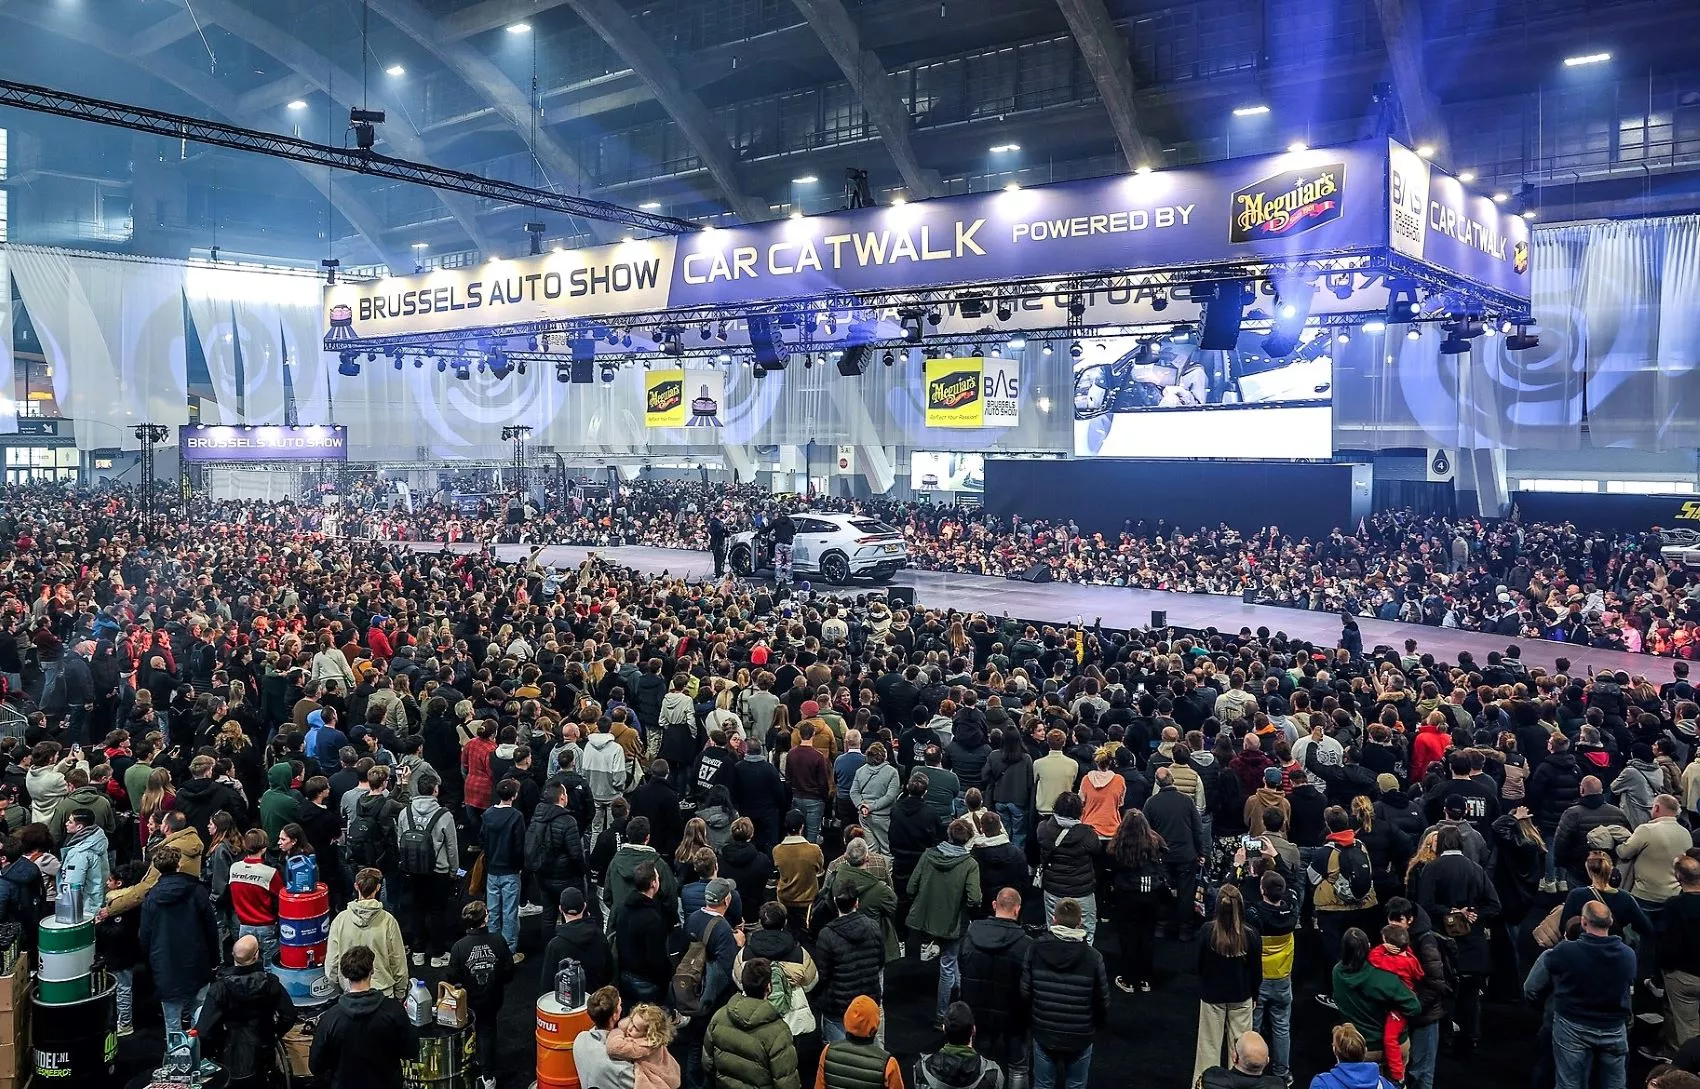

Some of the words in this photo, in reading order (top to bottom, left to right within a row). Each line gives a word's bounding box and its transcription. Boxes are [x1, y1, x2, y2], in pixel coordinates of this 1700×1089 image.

[1012, 209, 1150, 243] POWERED
[1154, 204, 1197, 228] BY
[1430, 200, 1457, 239] CAR
[1457, 214, 1508, 262] CATWALK
[682, 246, 759, 286] CAR
[767, 218, 987, 276] CATWALK
[359, 281, 483, 321] BRUSSELS
[488, 271, 561, 307] AUTO
[569, 258, 660, 297] SHOW
[984, 408, 999, 416] AUTO
[1000, 408, 1017, 416] SHOW
[986, 400, 1016, 409] BRUSSELS
[187, 438, 265, 448] BRUSSELS
[266, 437, 304, 447] AUTO
[306, 437, 344, 448] SHOW
[1437, 461, 1444, 470] 4
